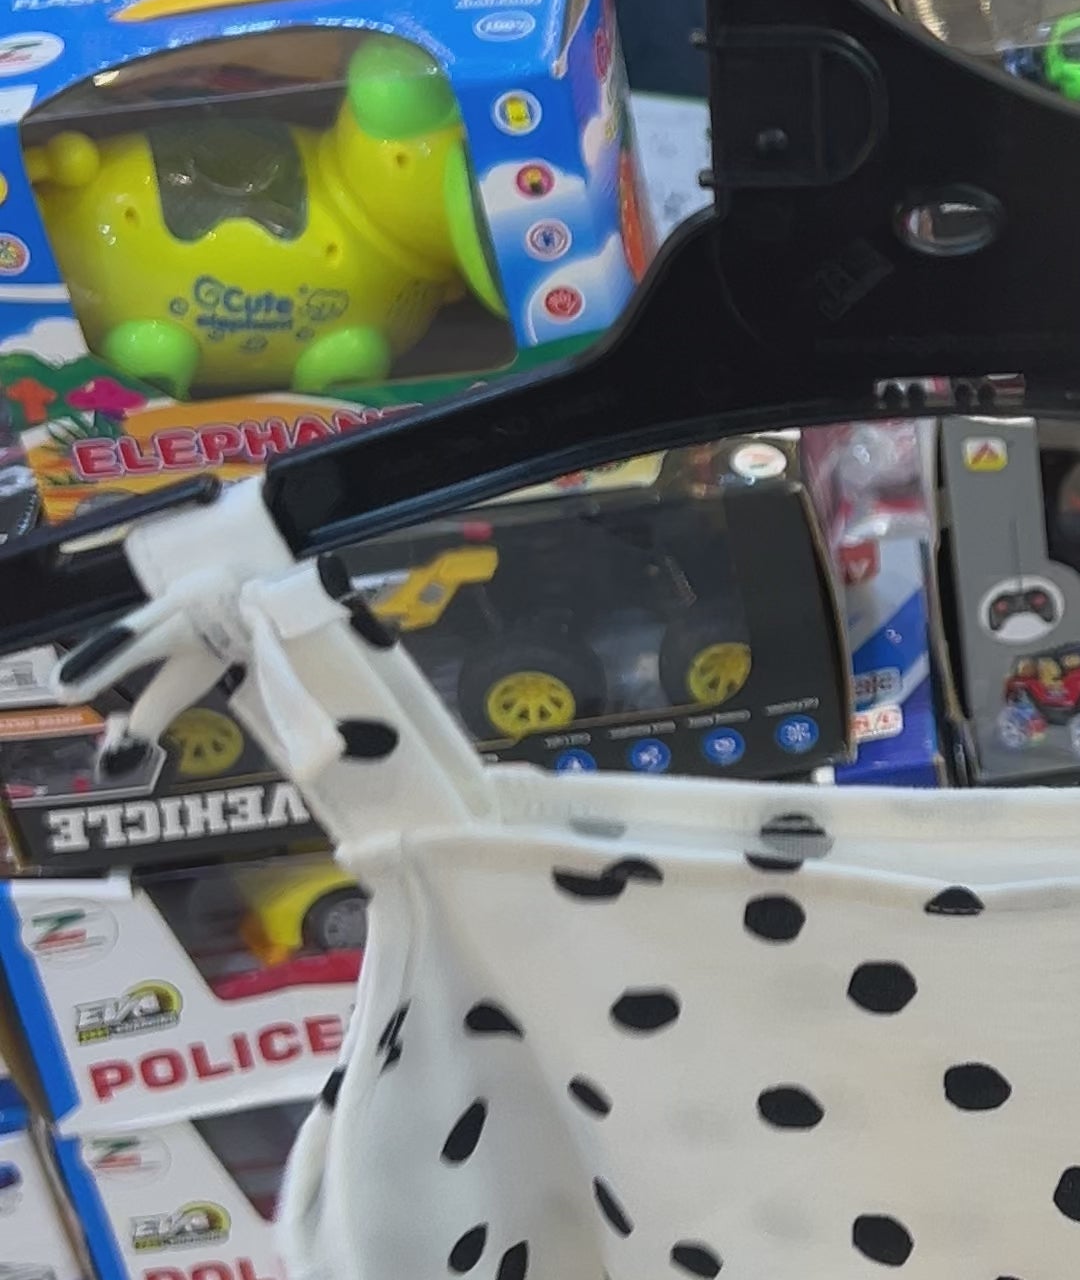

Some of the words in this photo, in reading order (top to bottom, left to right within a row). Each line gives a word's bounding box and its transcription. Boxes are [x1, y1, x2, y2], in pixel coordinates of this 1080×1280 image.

[72, 402, 424, 481] ELEPHA
[47, 781, 311, 854] VEHICLE
[87, 1013, 345, 1103] POLICE
